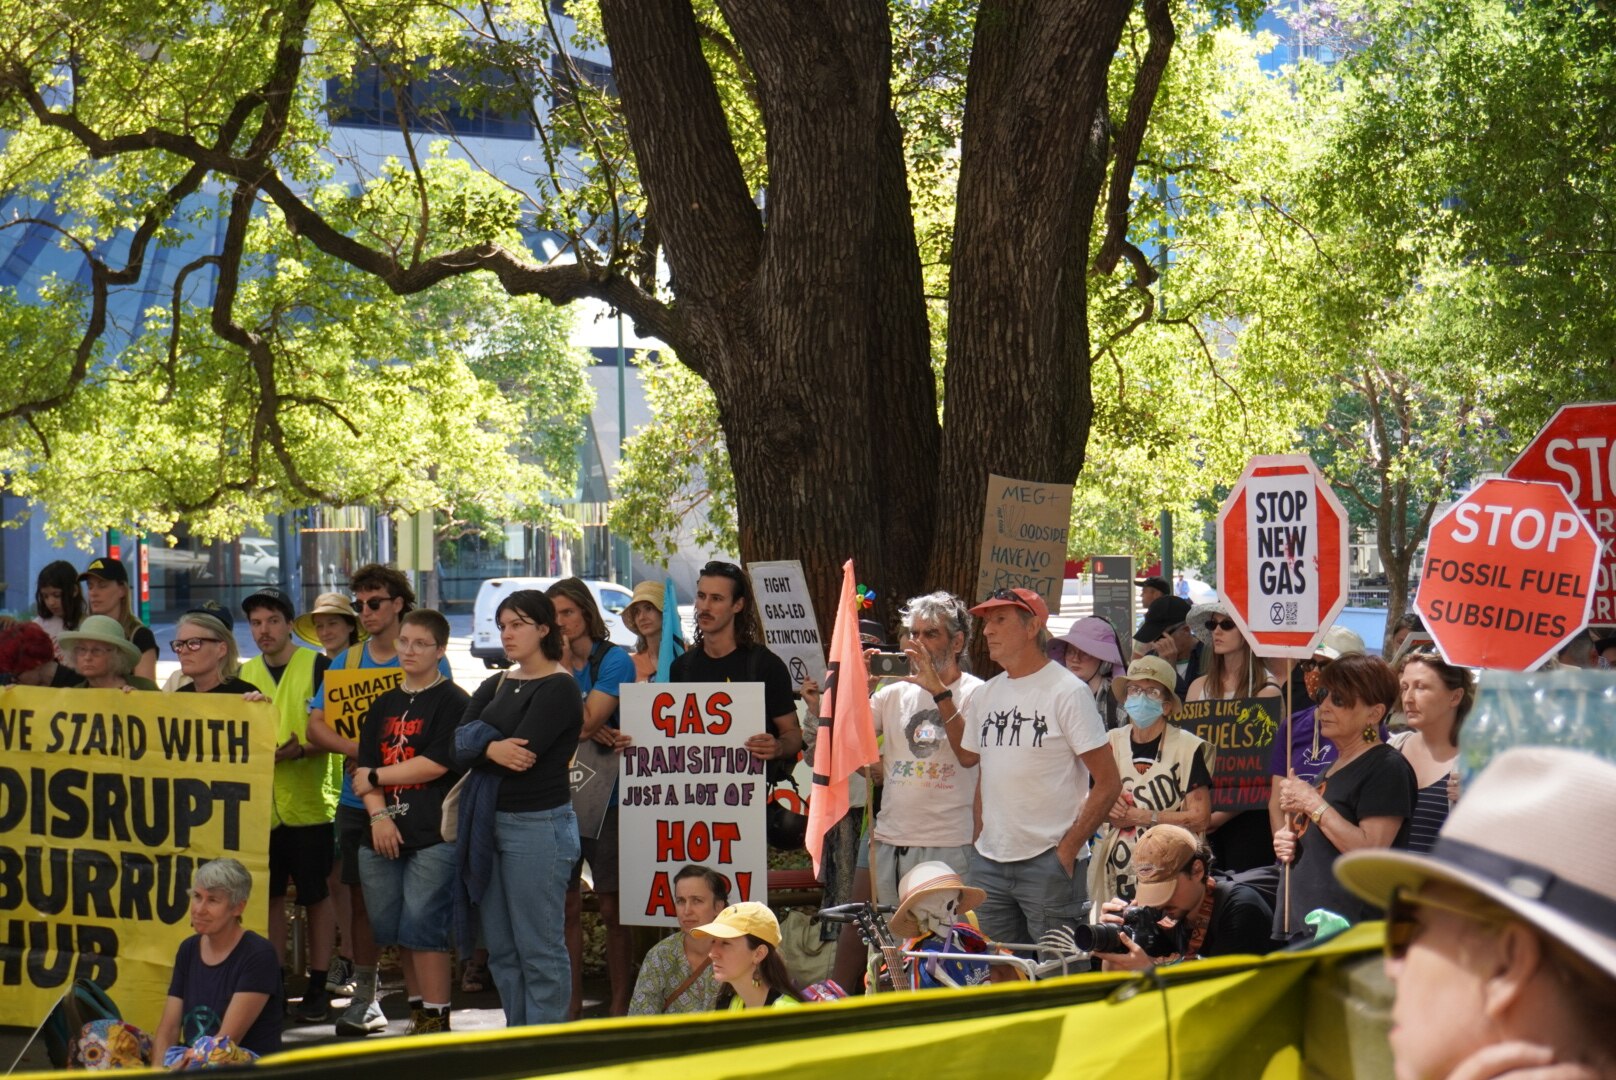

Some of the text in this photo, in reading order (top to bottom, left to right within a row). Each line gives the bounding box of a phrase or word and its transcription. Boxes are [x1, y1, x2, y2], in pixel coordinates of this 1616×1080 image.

[1545, 436, 1616, 502] ST
[1255, 490, 1307, 524] STOP
[1257, 525, 1307, 558] NEW
[1451, 502, 1579, 552] STOP
[990, 545, 1051, 568] HAVE NO
[763, 577, 792, 593] FIGHT
[994, 567, 1056, 597] RESPECT
[1259, 561, 1306, 595] GAS
[1426, 558, 1512, 589] FOSSIL
[1519, 569, 1586, 598] FUEL
[764, 603, 806, 619] GAS-LED
[1428, 600, 1567, 638] SUBSIDIES
[765, 629, 819, 645] EXTINCTION
[328, 672, 404, 703] CLIMATE
[651, 692, 733, 738] GAS
[1168, 700, 1242, 721] OSSILS LIKE
[46, 711, 147, 761] STAND
[158, 716, 249, 764] WITH
[1196, 722, 1254, 749] FUELS
[623, 746, 764, 777] TRANSITION
[0, 766, 250, 851] DISRUPT
[622, 784, 662, 806] JUST
[664, 784, 679, 806] A
[684, 783, 719, 806] LOT
[724, 782, 755, 806] OF
[656, 819, 741, 864] HOT
[0, 846, 212, 925] BURRU
[0, 919, 119, 991] HUB
